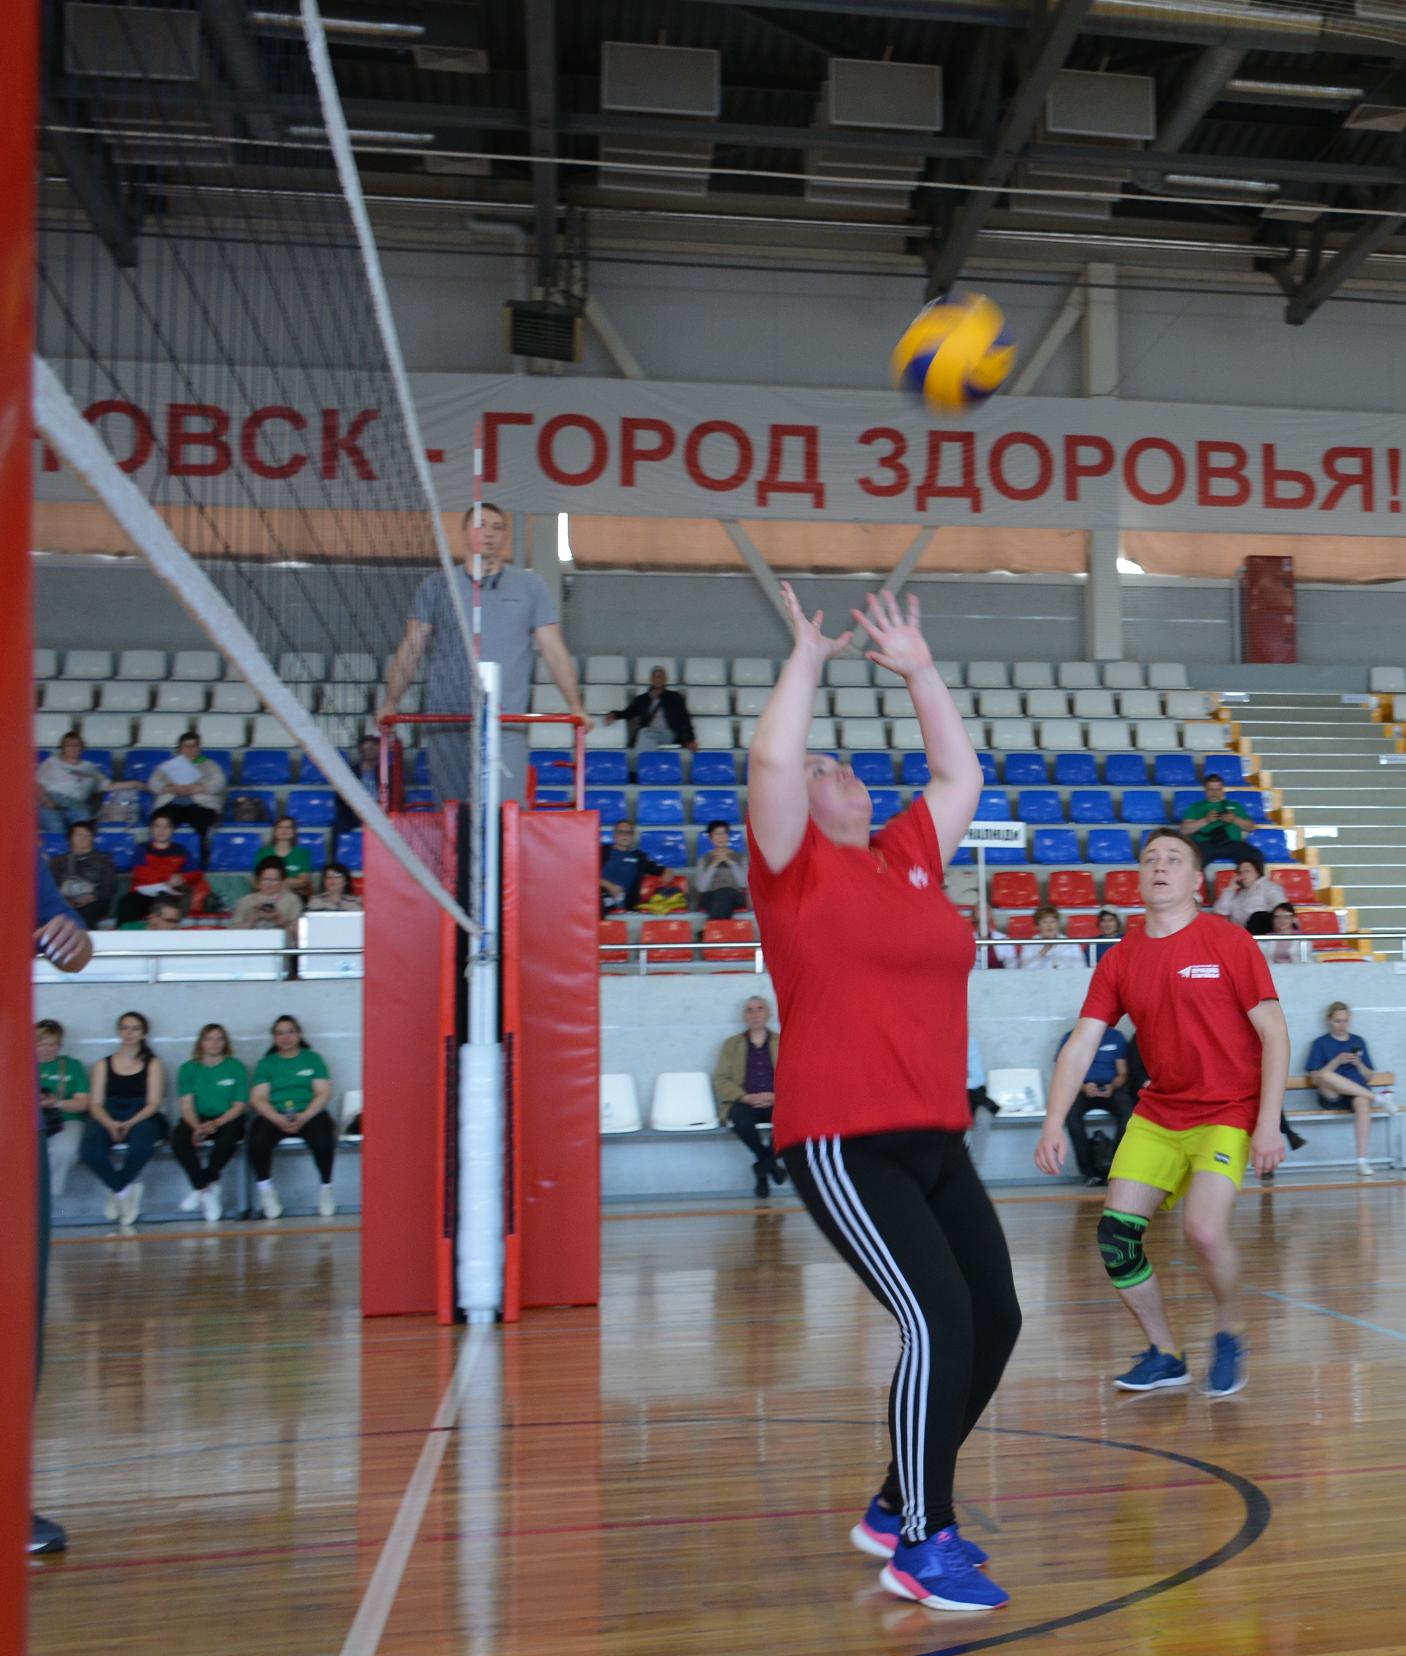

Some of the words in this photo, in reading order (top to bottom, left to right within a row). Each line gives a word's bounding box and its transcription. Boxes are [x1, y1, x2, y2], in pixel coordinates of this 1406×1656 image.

[34, 400, 380, 481] ОВСК
[481, 412, 825, 511] ГОРОД
[856, 426, 1404, 515] ЗДОРОВЬЯ!
